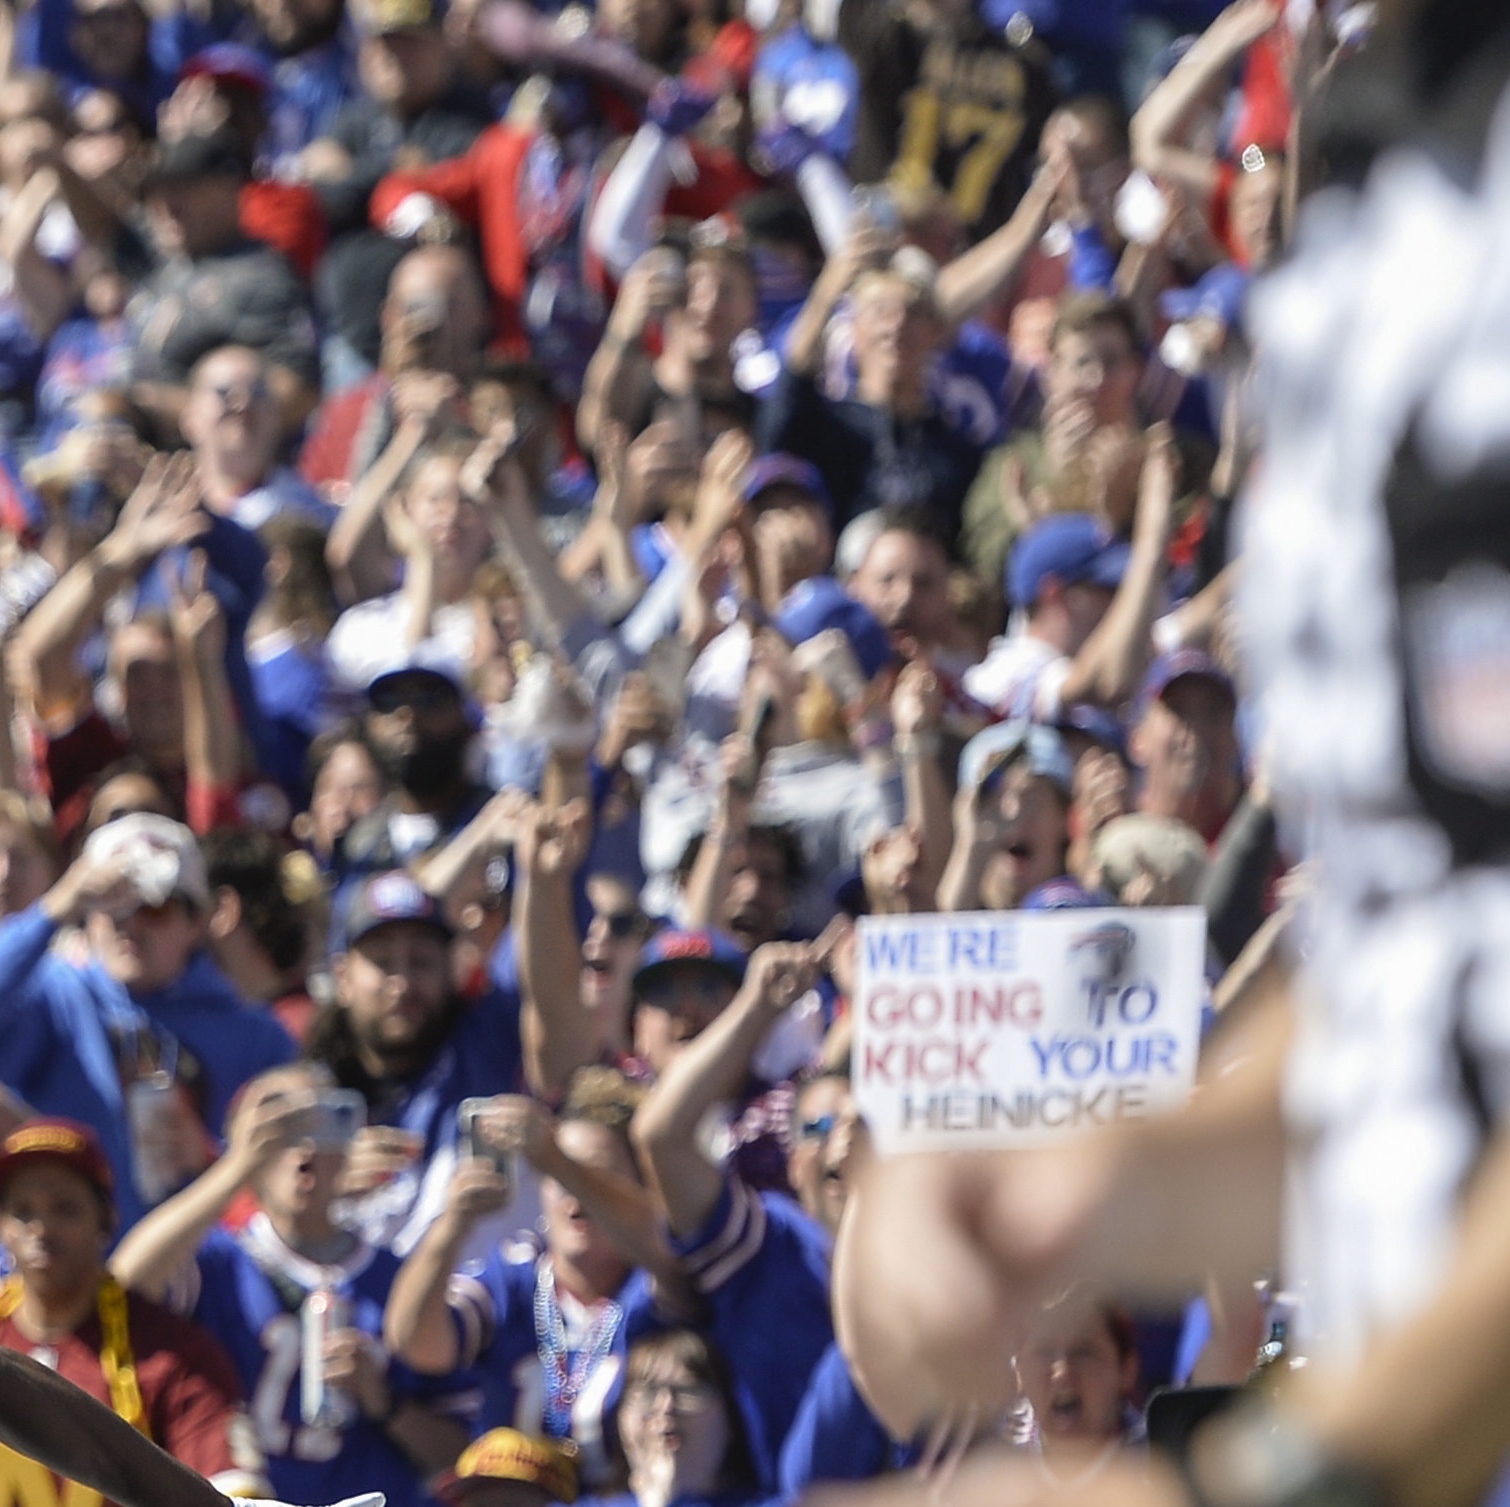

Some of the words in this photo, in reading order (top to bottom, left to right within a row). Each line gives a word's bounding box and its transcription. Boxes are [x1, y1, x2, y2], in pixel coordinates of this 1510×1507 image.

[865, 978, 1043, 1032] GOING
[1082, 979, 1157, 1030] TO
[864, 1038, 987, 1083] KICK
[1031, 1036, 1179, 1081] YOUR
[901, 1084, 1147, 1132] HEINICKE
